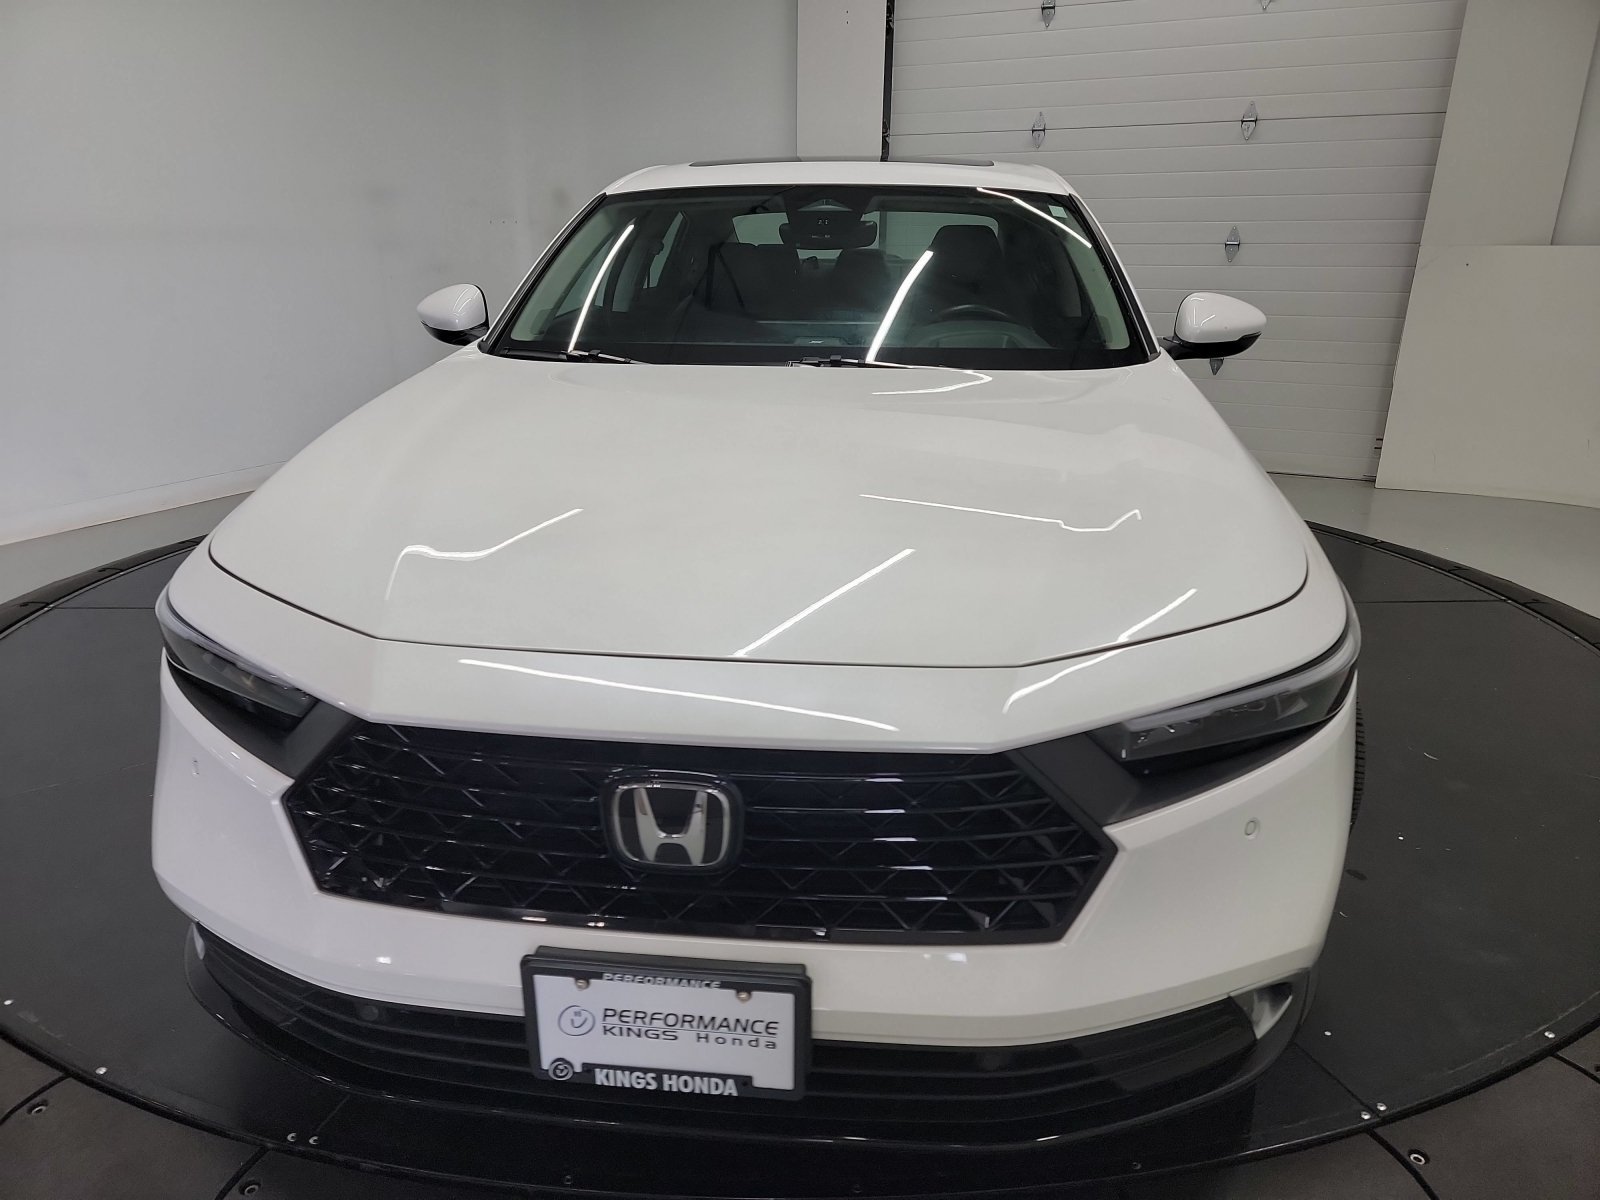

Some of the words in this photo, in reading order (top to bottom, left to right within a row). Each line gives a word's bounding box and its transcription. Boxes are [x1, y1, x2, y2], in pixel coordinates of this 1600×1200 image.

[602, 1008, 779, 1035] PERFORMANCE
[602, 1025, 678, 1041] KINGS
[696, 1032, 777, 1049] Honda
[594, 1068, 658, 1090] KINGS
[662, 1074, 738, 1096] HONDA
